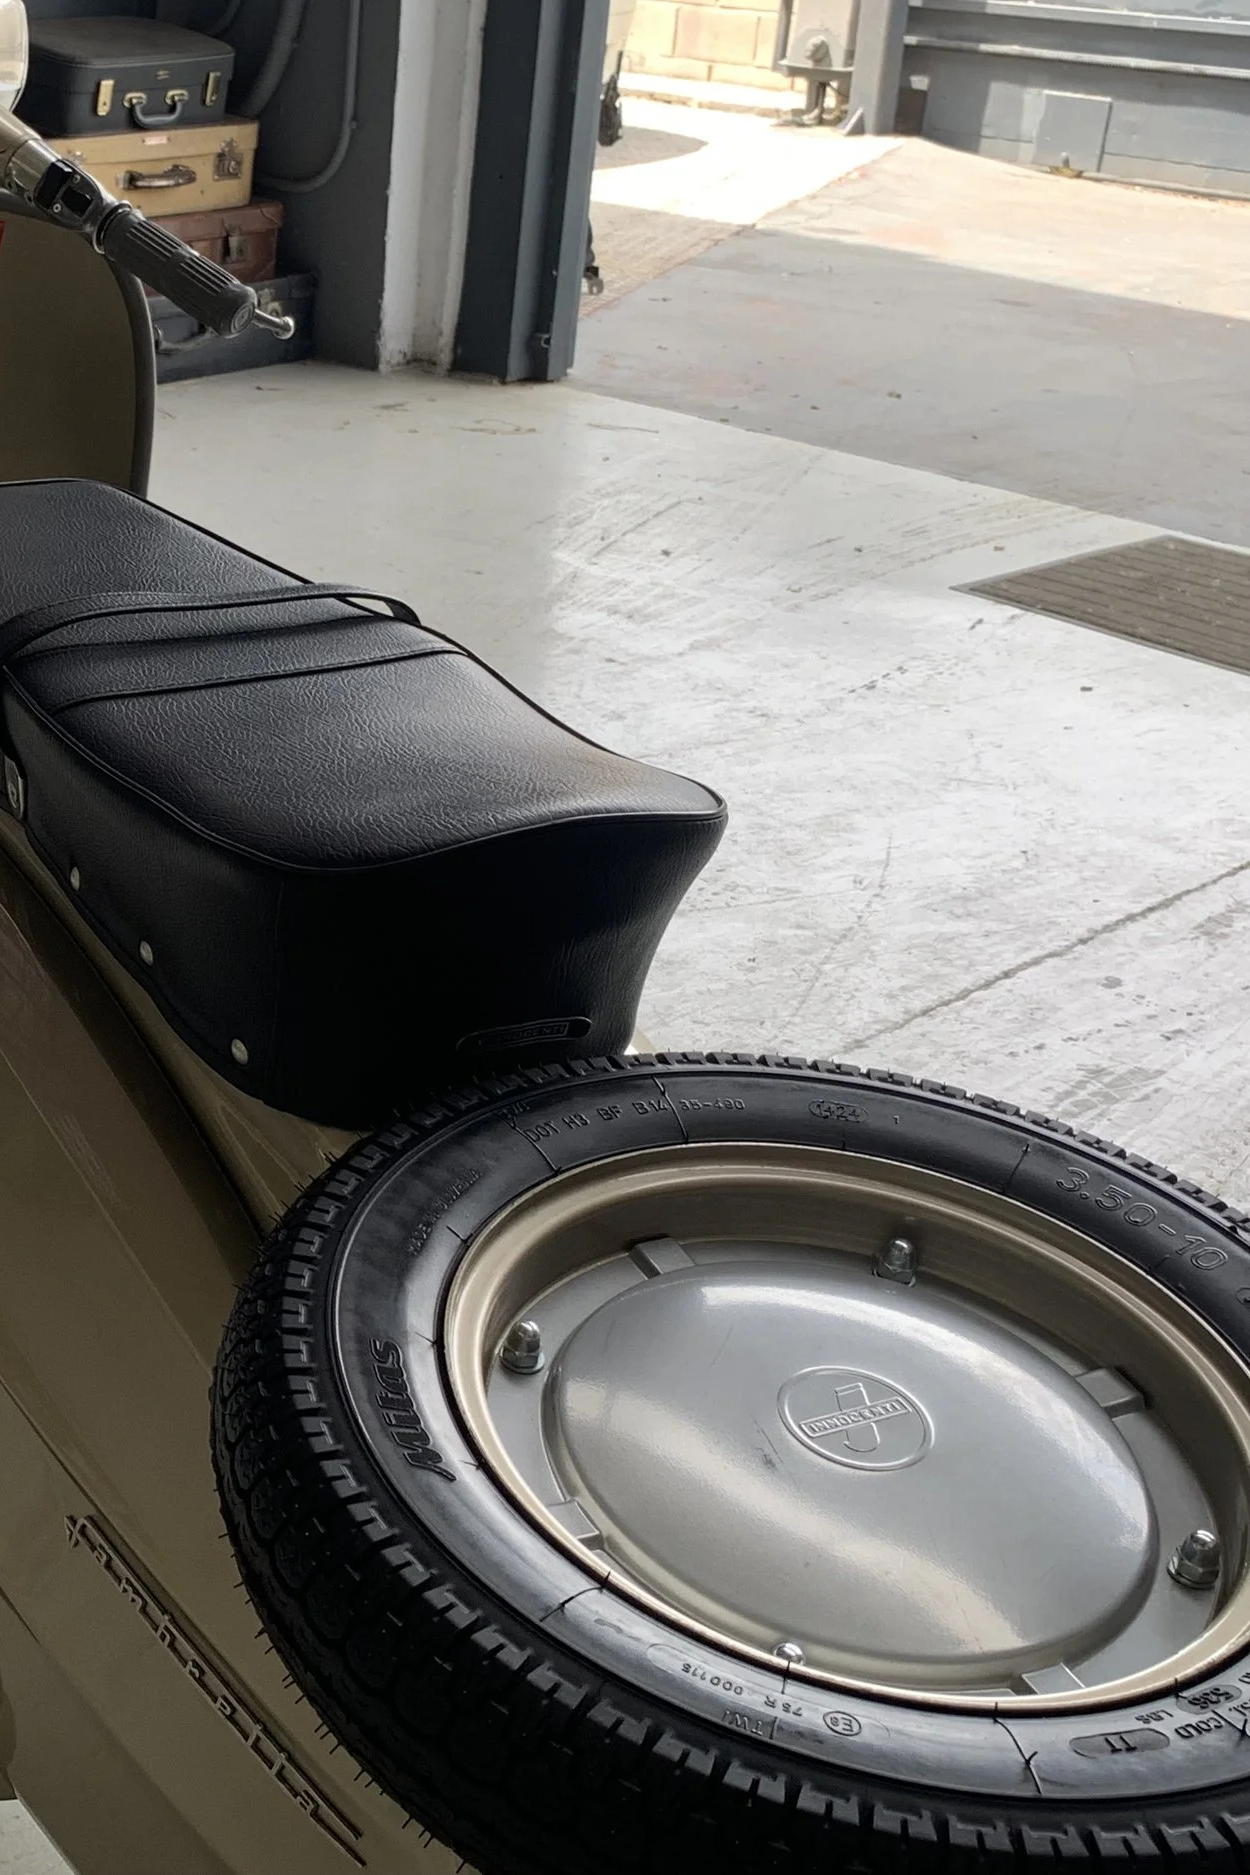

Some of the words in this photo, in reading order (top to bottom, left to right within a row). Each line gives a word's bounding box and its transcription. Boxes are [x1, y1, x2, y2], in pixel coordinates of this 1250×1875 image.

[523, 1120, 560, 1142] DOT
[1056, 1166, 1230, 1271] 3.50-10
[806, 1400, 903, 1434] INNOCENTI
[681, 1661, 744, 1696] 000115
[722, 1710, 764, 1736] TWI
[1174, 1715, 1226, 1739] COLD
[1103, 1734, 1137, 1753] TT
